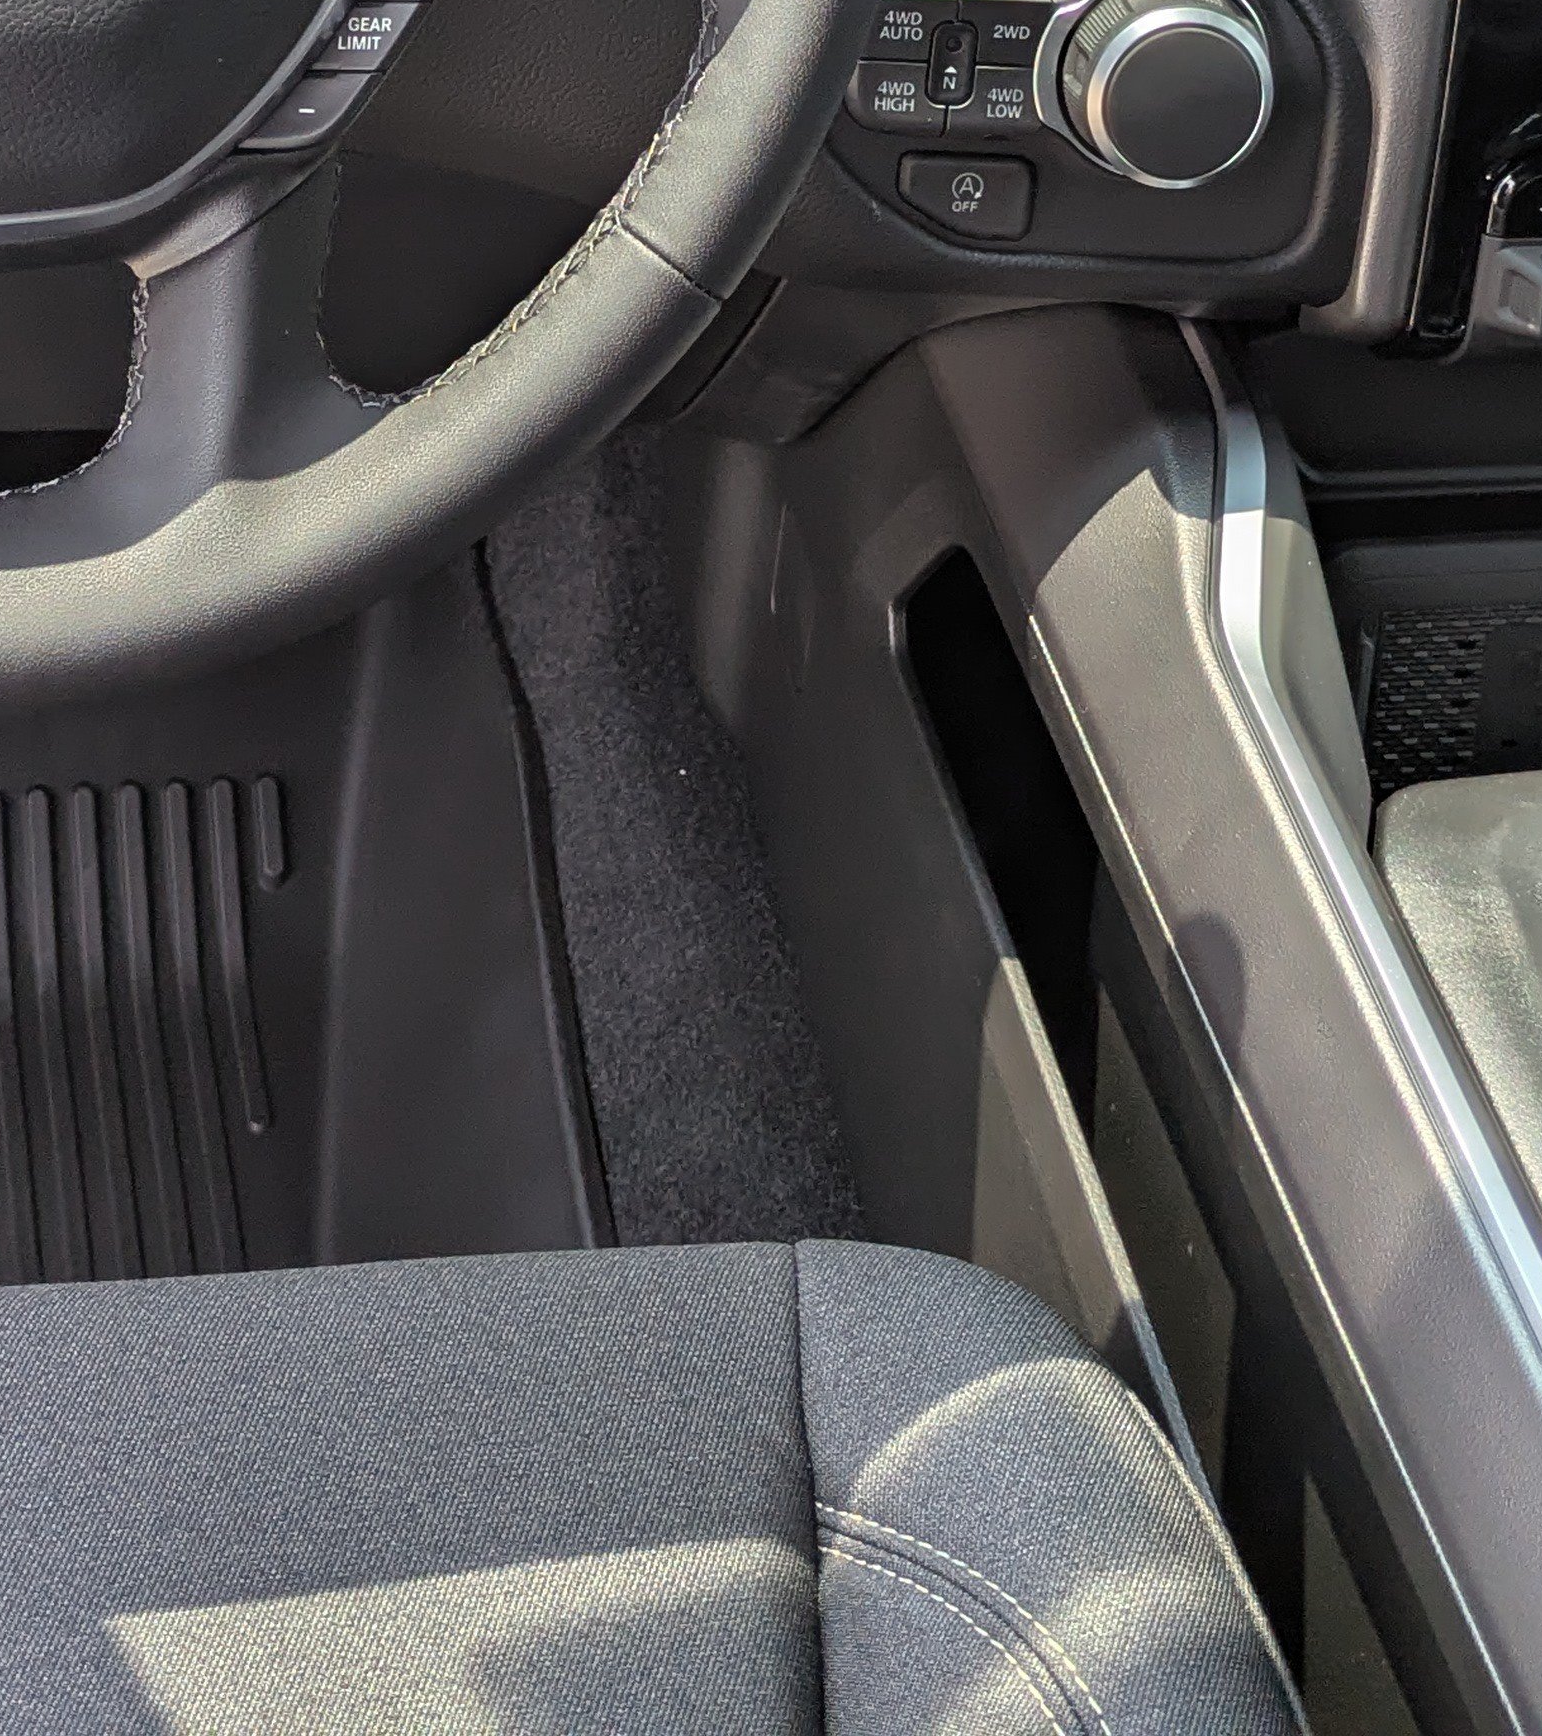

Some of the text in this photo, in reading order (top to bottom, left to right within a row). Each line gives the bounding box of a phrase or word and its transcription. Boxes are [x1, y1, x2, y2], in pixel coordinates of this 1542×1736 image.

[348, 17, 392, 32] GEAR
[884, 11, 923, 26] 4WD
[880, 26, 923, 41] AUTO
[992, 24, 1031, 41] 2WD
[337, 36, 382, 50] LIMIT
[877, 80, 915, 96] 4WD
[942, 76, 957, 90] N
[986, 87, 1024, 103] 4WD
[874, 96, 915, 112] HIGH
[986, 103, 1022, 119] LOW
[952, 199, 978, 213] OFF
